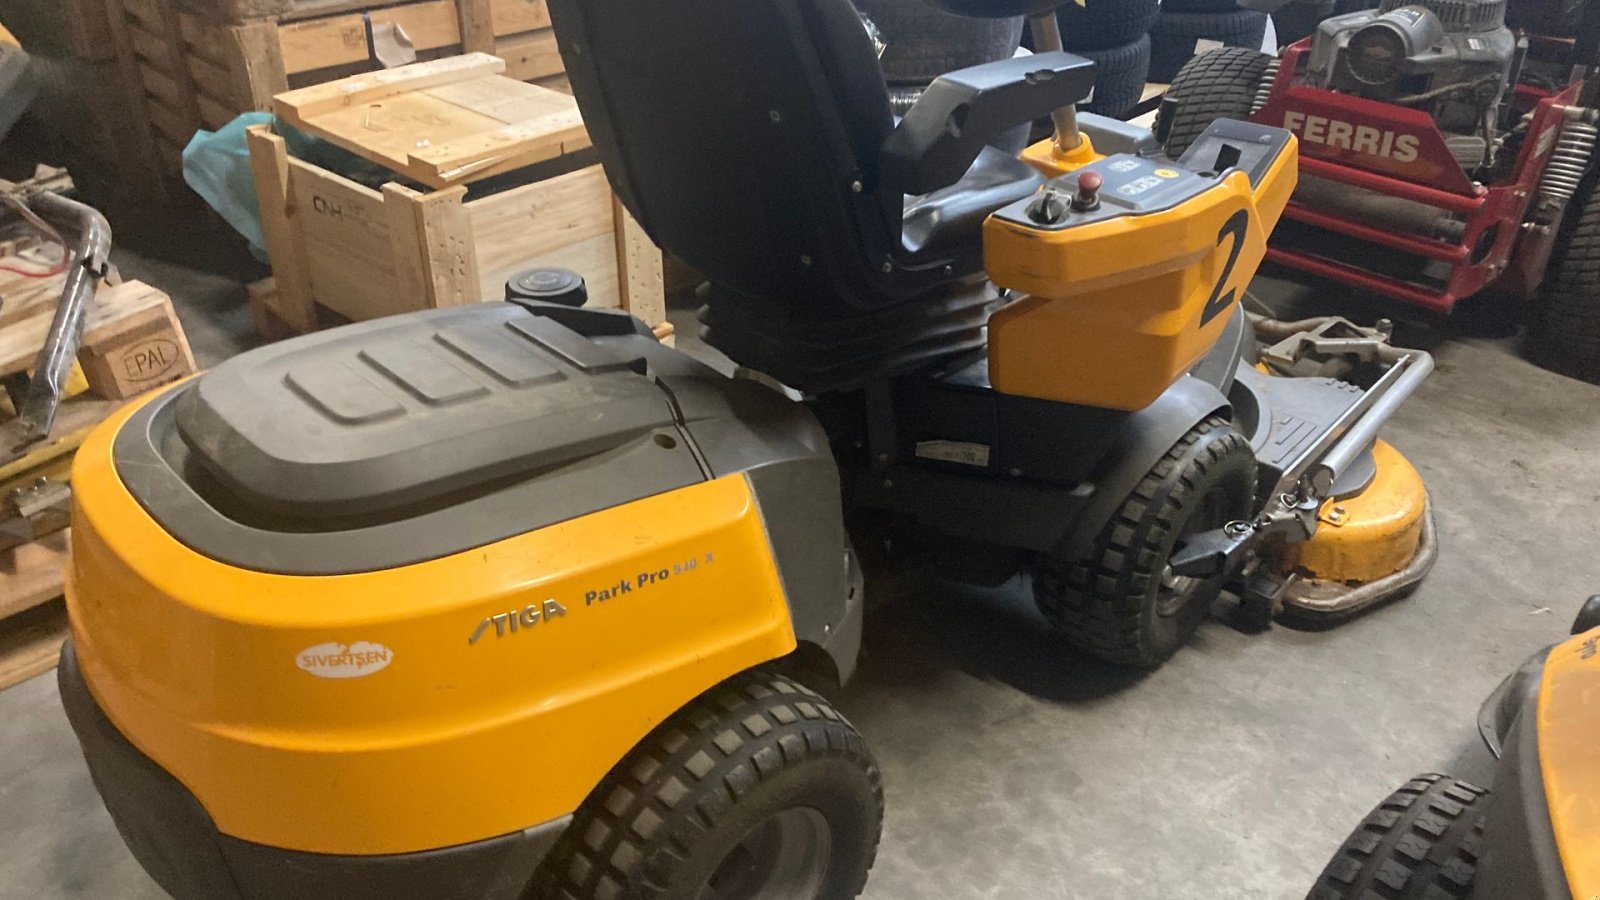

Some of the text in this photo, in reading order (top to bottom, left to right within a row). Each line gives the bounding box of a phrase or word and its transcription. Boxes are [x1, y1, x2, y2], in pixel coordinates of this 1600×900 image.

[1282, 110, 1420, 163] FERRIS
[1198, 207, 1249, 328] 2
[584, 579, 633, 607] Park
[636, 567, 670, 589] Pro
[468, 598, 567, 646] STIGA
[301, 651, 389, 669] SIVERTSEN
